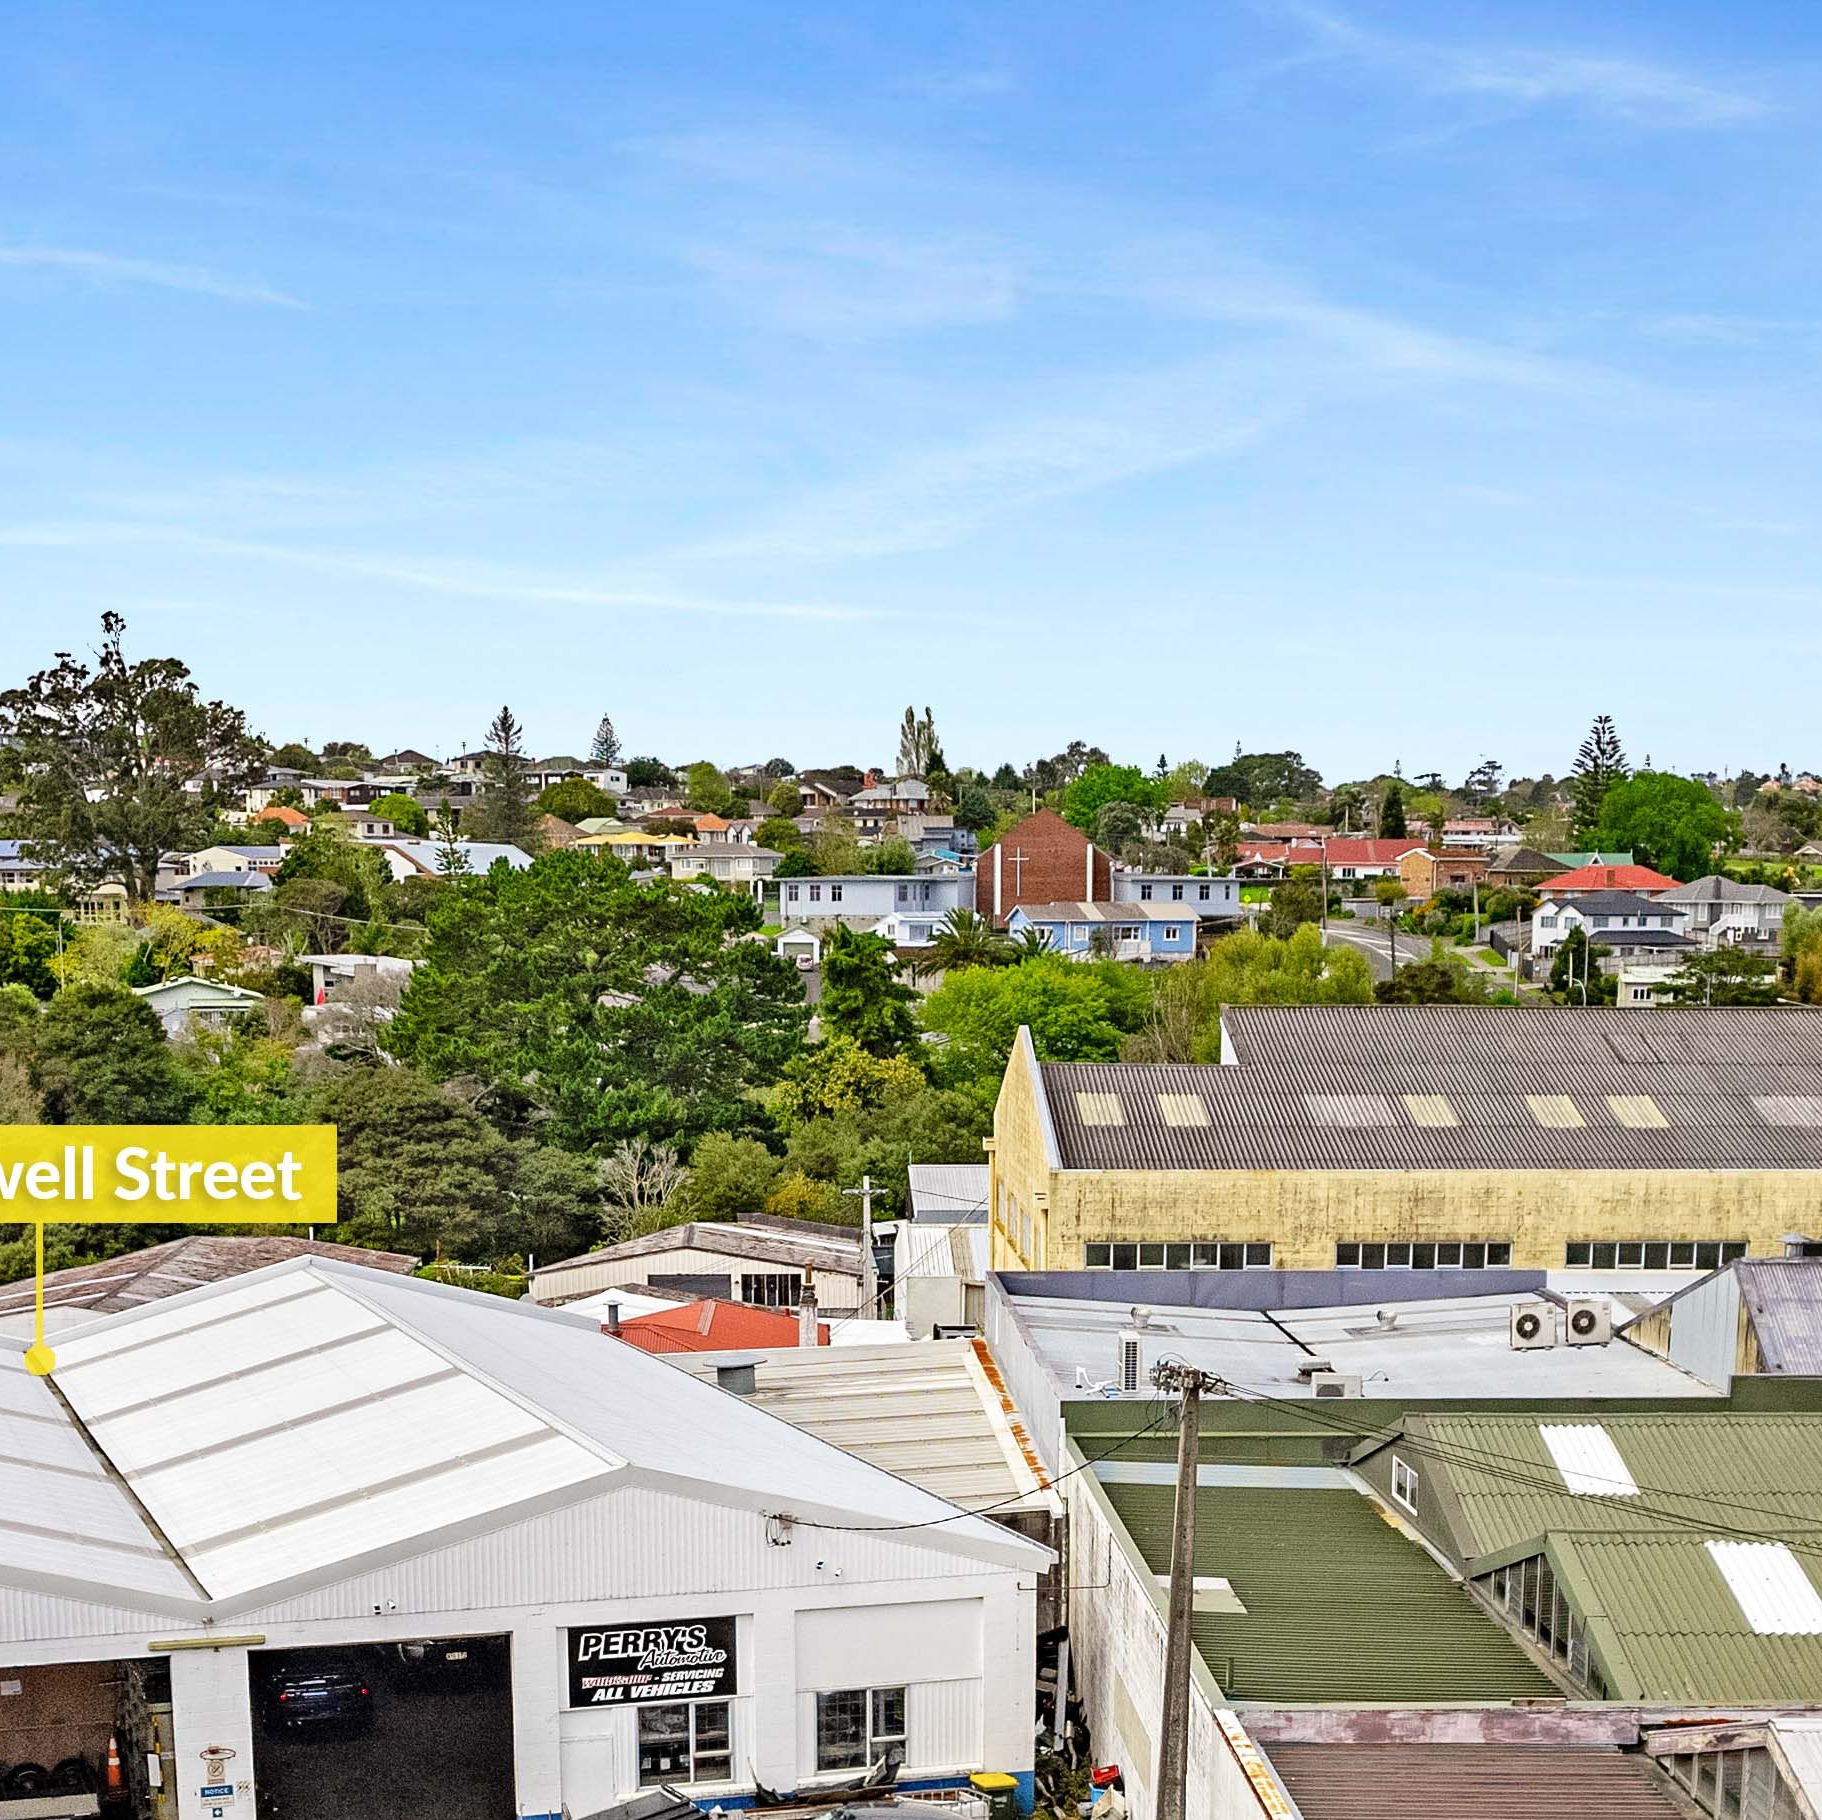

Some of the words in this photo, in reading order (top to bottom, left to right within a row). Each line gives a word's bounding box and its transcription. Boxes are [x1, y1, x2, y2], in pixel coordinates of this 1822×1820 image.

[578, 1625, 706, 1662] PERRY'S
[637, 1647, 727, 1671] Automotive
[661, 1668, 725, 1683] SERVICING
[591, 1688, 625, 1702] ALL
[630, 1680, 716, 1699] VEHICLES
